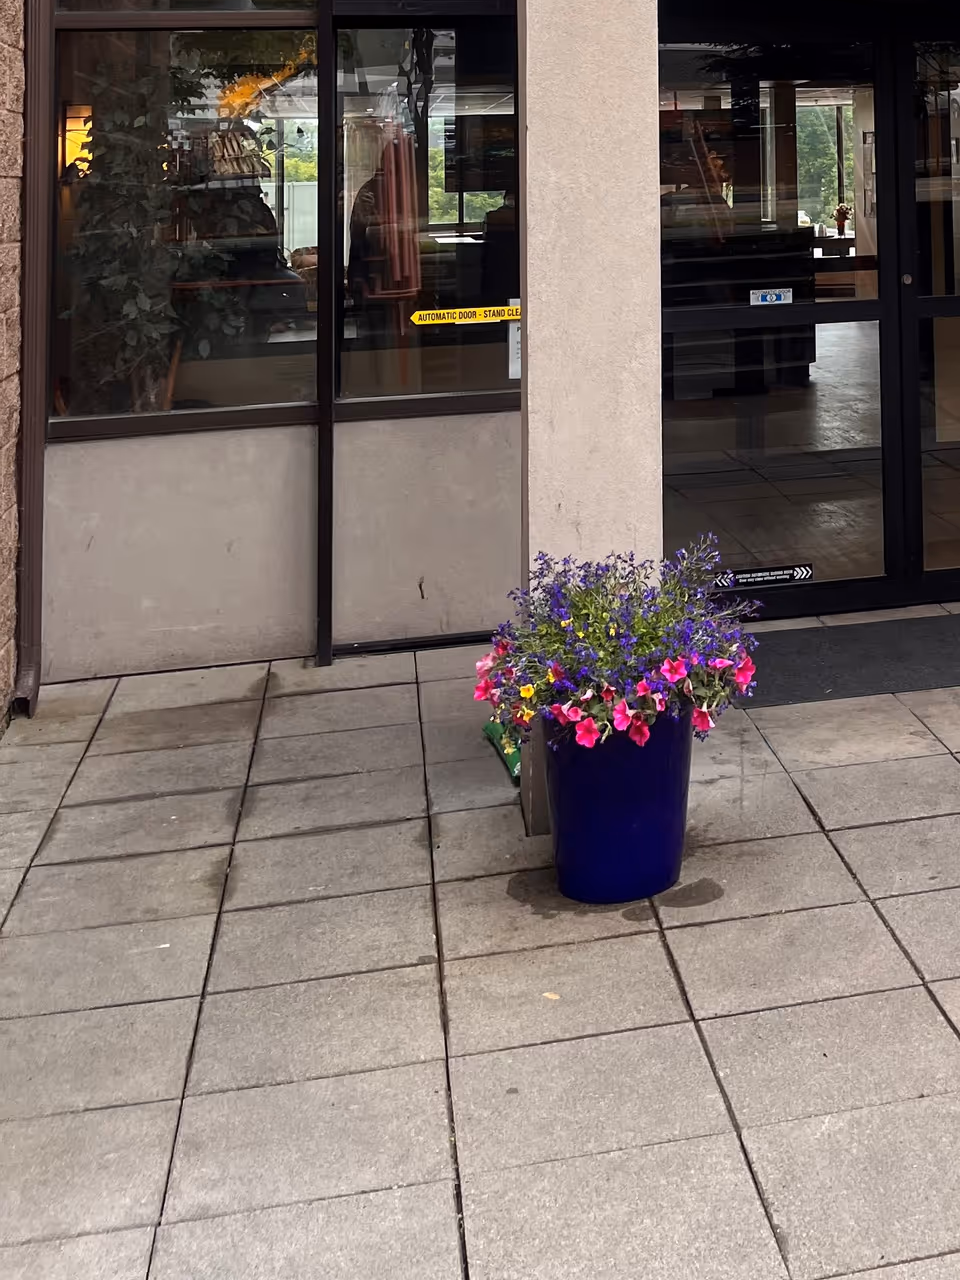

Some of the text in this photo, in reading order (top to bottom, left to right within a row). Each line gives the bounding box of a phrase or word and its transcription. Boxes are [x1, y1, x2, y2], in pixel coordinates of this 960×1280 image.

[418, 311, 457, 322] AUTOMATIC
[458, 310, 477, 320] DOOR
[483, 308, 506, 319] STAND
